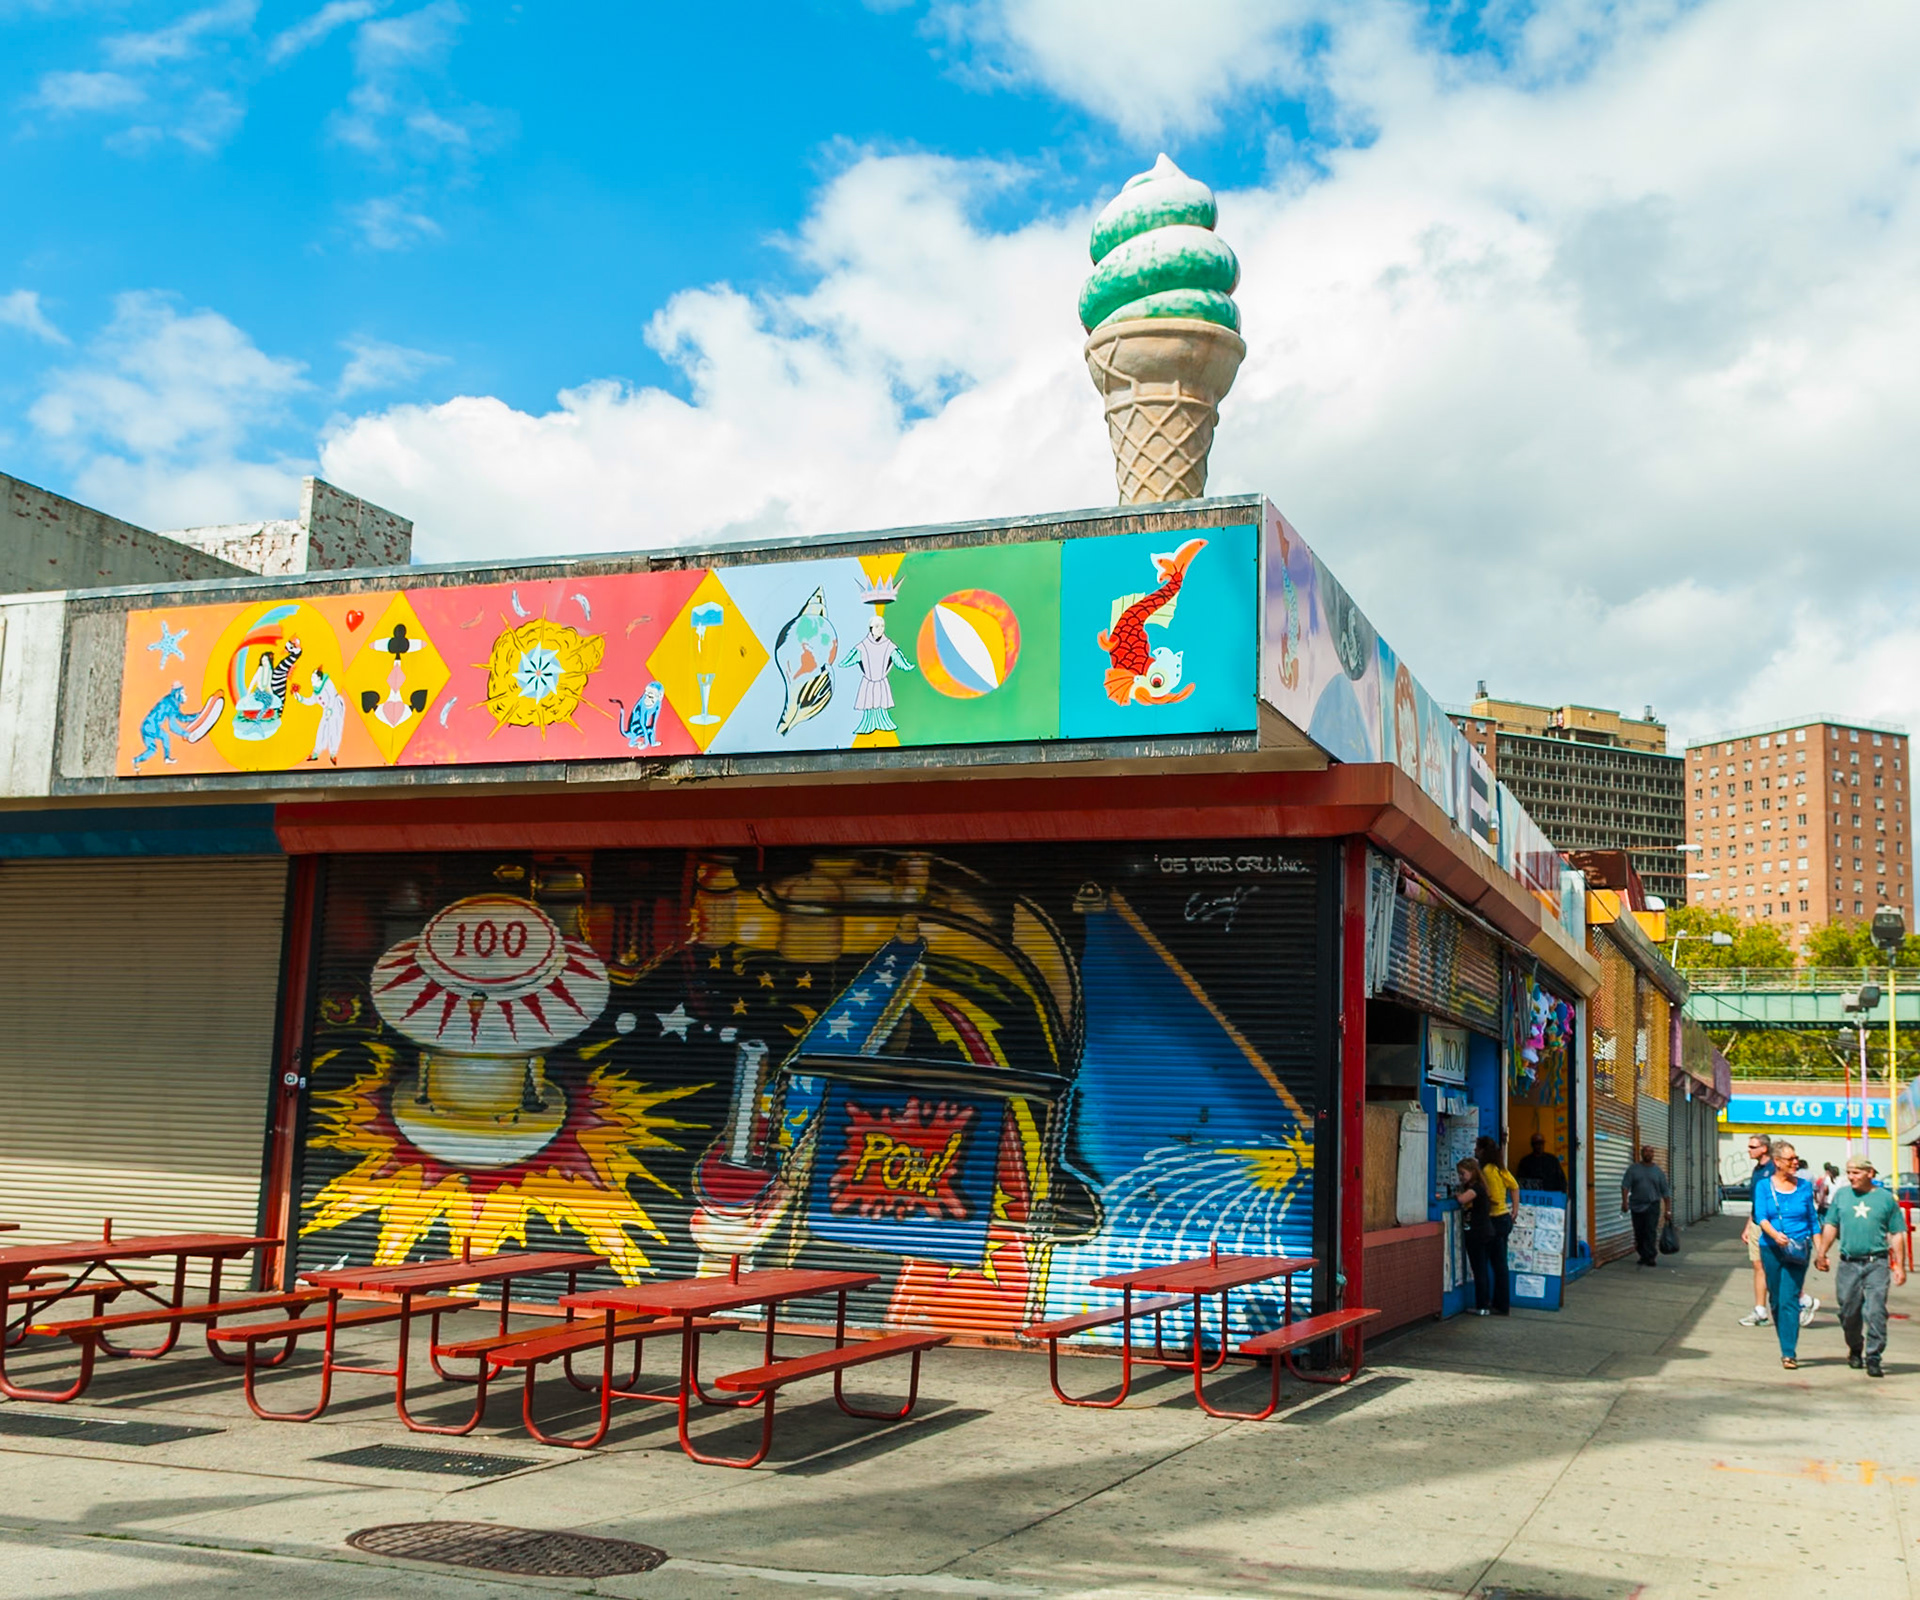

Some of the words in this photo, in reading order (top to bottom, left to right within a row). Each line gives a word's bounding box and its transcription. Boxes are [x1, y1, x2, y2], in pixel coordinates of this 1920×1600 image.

[1190, 856, 1233, 873] TATS
[453, 920, 528, 958] 100
[1764, 1101, 1823, 1117] LAGO
